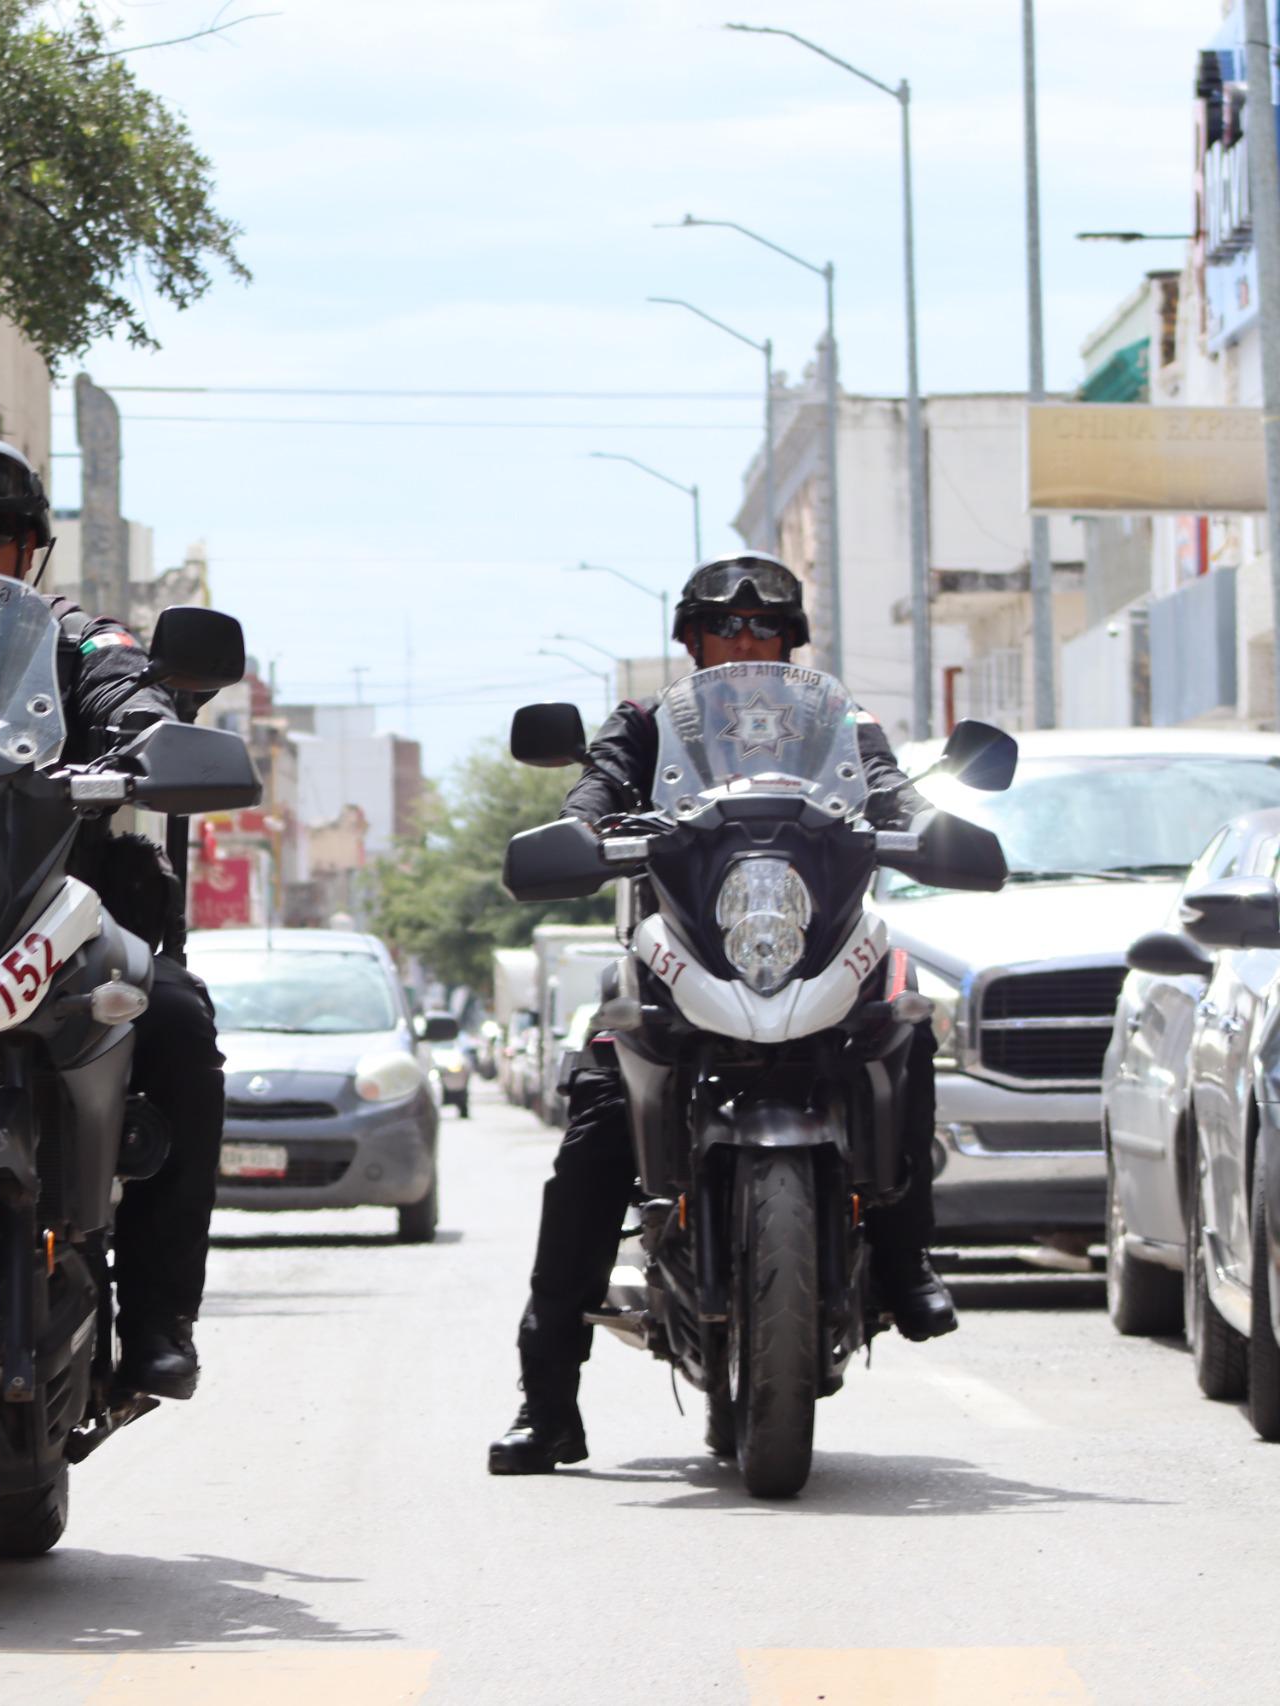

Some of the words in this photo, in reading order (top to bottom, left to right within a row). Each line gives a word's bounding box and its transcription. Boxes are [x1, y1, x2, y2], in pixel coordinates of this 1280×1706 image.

[1052, 413, 1155, 441] CHINA
[1166, 414, 1264, 441] EXPRE
[648, 943, 687, 986] 151
[842, 937, 879, 981] 151
